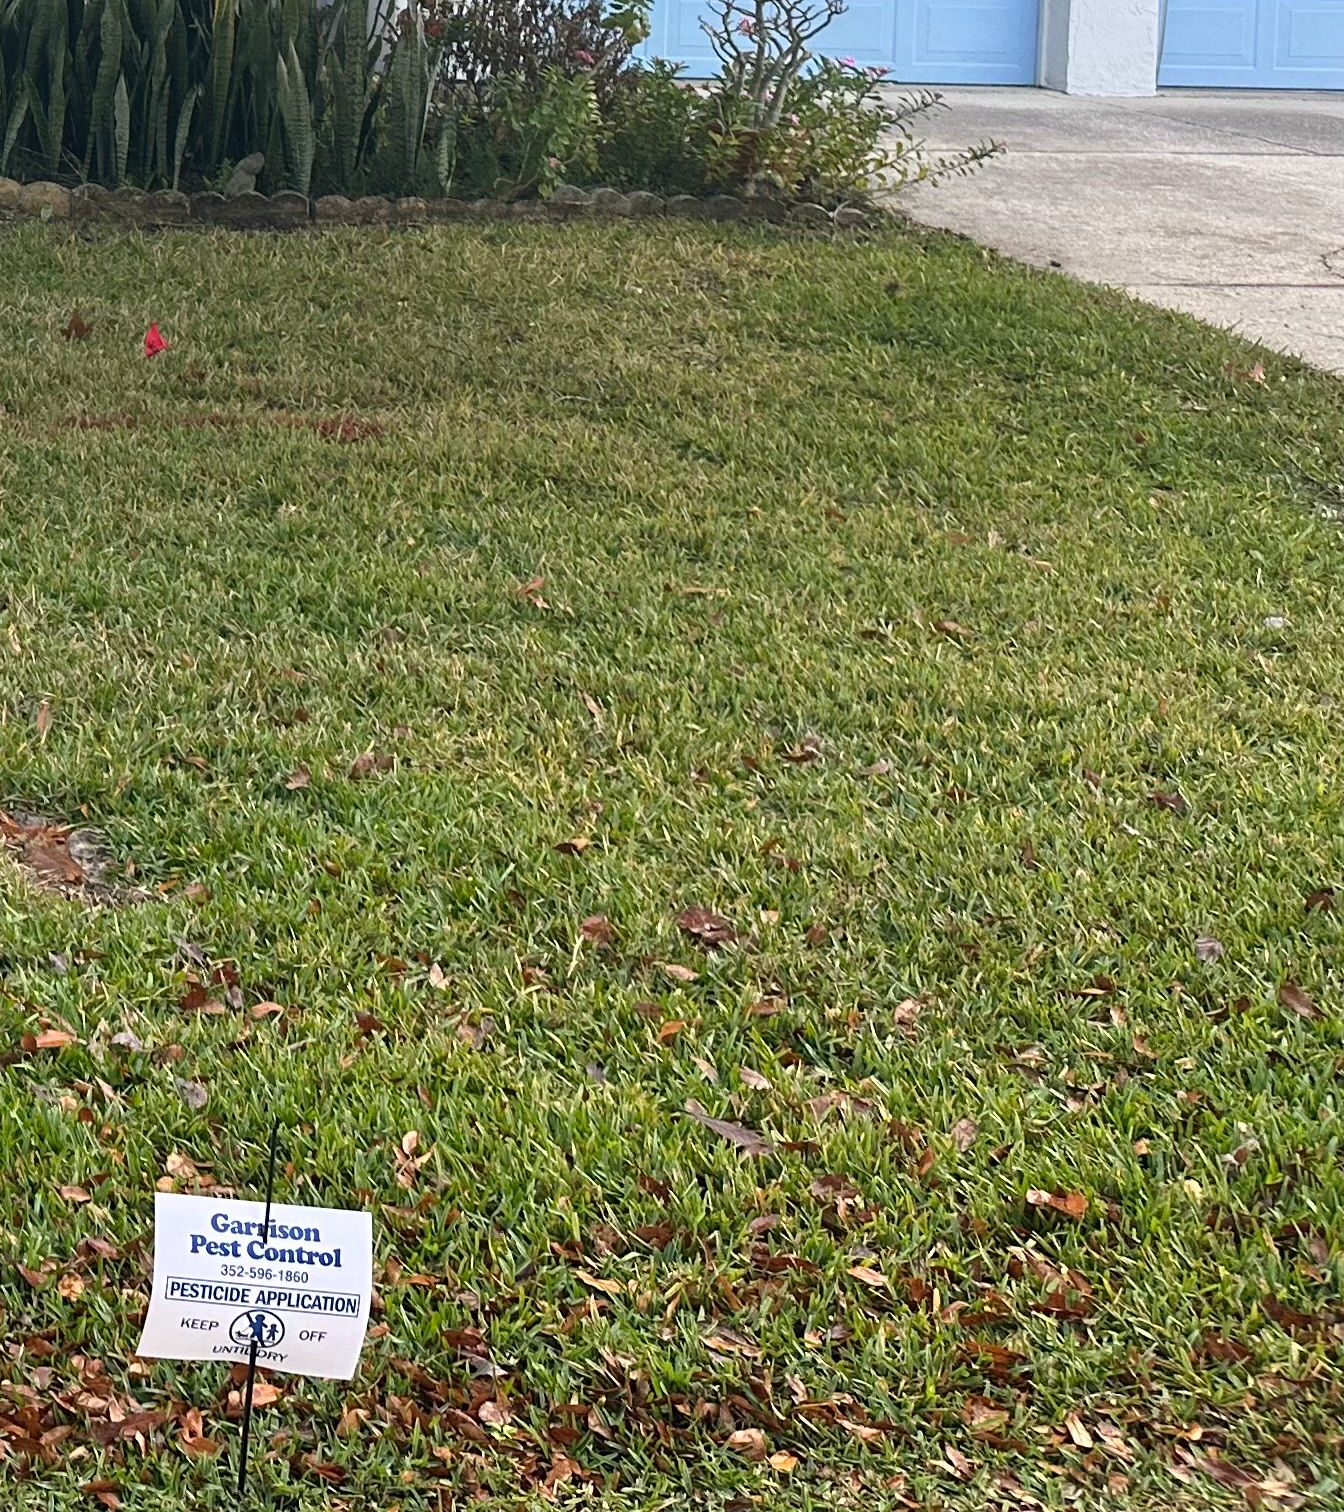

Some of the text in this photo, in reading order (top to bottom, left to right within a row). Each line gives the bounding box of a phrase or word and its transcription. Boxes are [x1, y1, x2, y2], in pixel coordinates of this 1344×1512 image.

[190, 1234, 342, 1268] Pest Control
[220, 1264, 309, 1284] 352-596-1860
[169, 1281, 359, 1315] PESTICIDE APPLICATION
[180, 1317, 328, 1343] KEEP OFF
[255, 1348, 289, 1363] DRY
